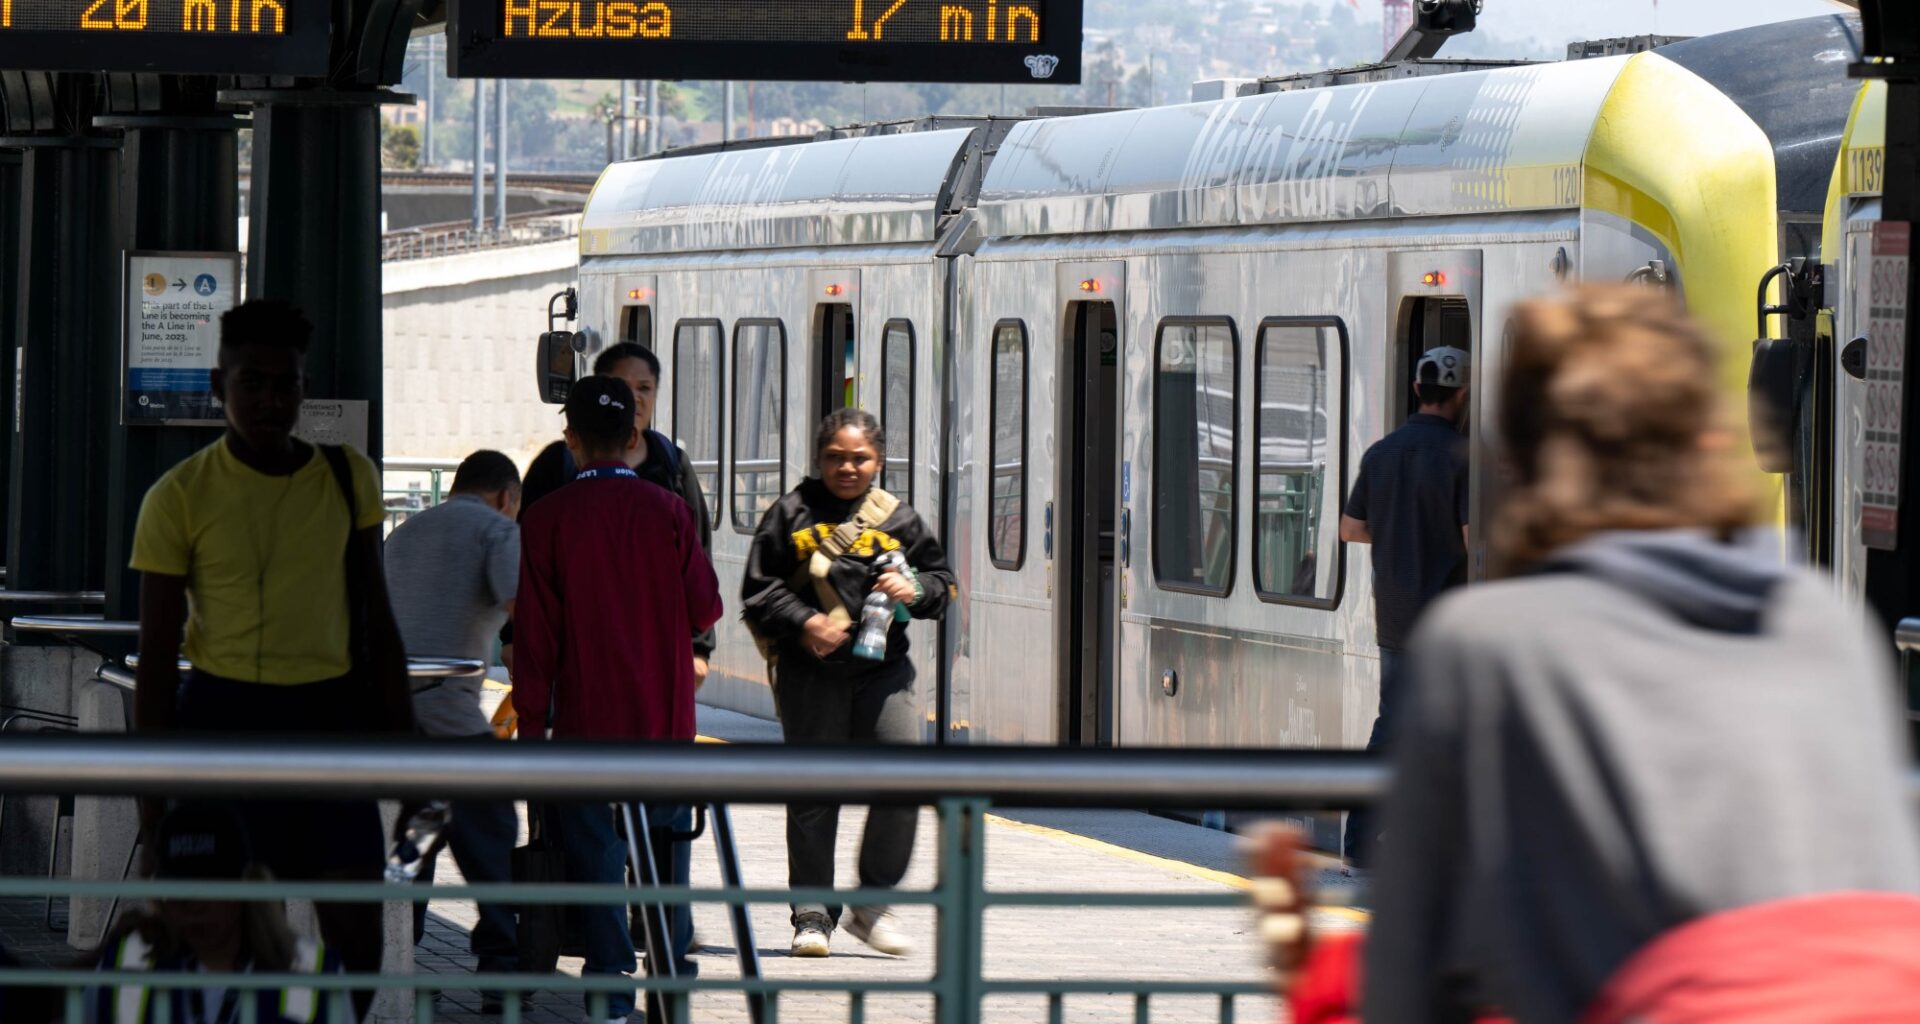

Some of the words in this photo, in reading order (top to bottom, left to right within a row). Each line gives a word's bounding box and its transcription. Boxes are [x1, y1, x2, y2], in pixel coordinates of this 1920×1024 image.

[184, 0, 284, 33] min
[505, 0, 671, 37] Azusa
[941, 0, 1039, 41] min
[1178, 101, 1283, 223] Metro
[1279, 84, 1378, 218] Rail
[1852, 149, 1882, 192] 1139
[1553, 167, 1577, 205] 1120
[199, 278, 212, 293] A
[162, 302, 180, 311] part
[182, 301, 192, 310] of
[194, 301, 207, 310] the
[208, 302, 215, 310] L
[142, 312, 159, 320] Line
[160, 312, 167, 320] is
[169, 311, 210, 323] becoming
[142, 321, 155, 330] the
[158, 322, 164, 330] A
[167, 321, 185, 330] Line
[187, 321, 195, 330] in
[142, 332, 163, 342] June,
[165, 334, 188, 342] 2023.
[1442, 355, 1456, 369] C
